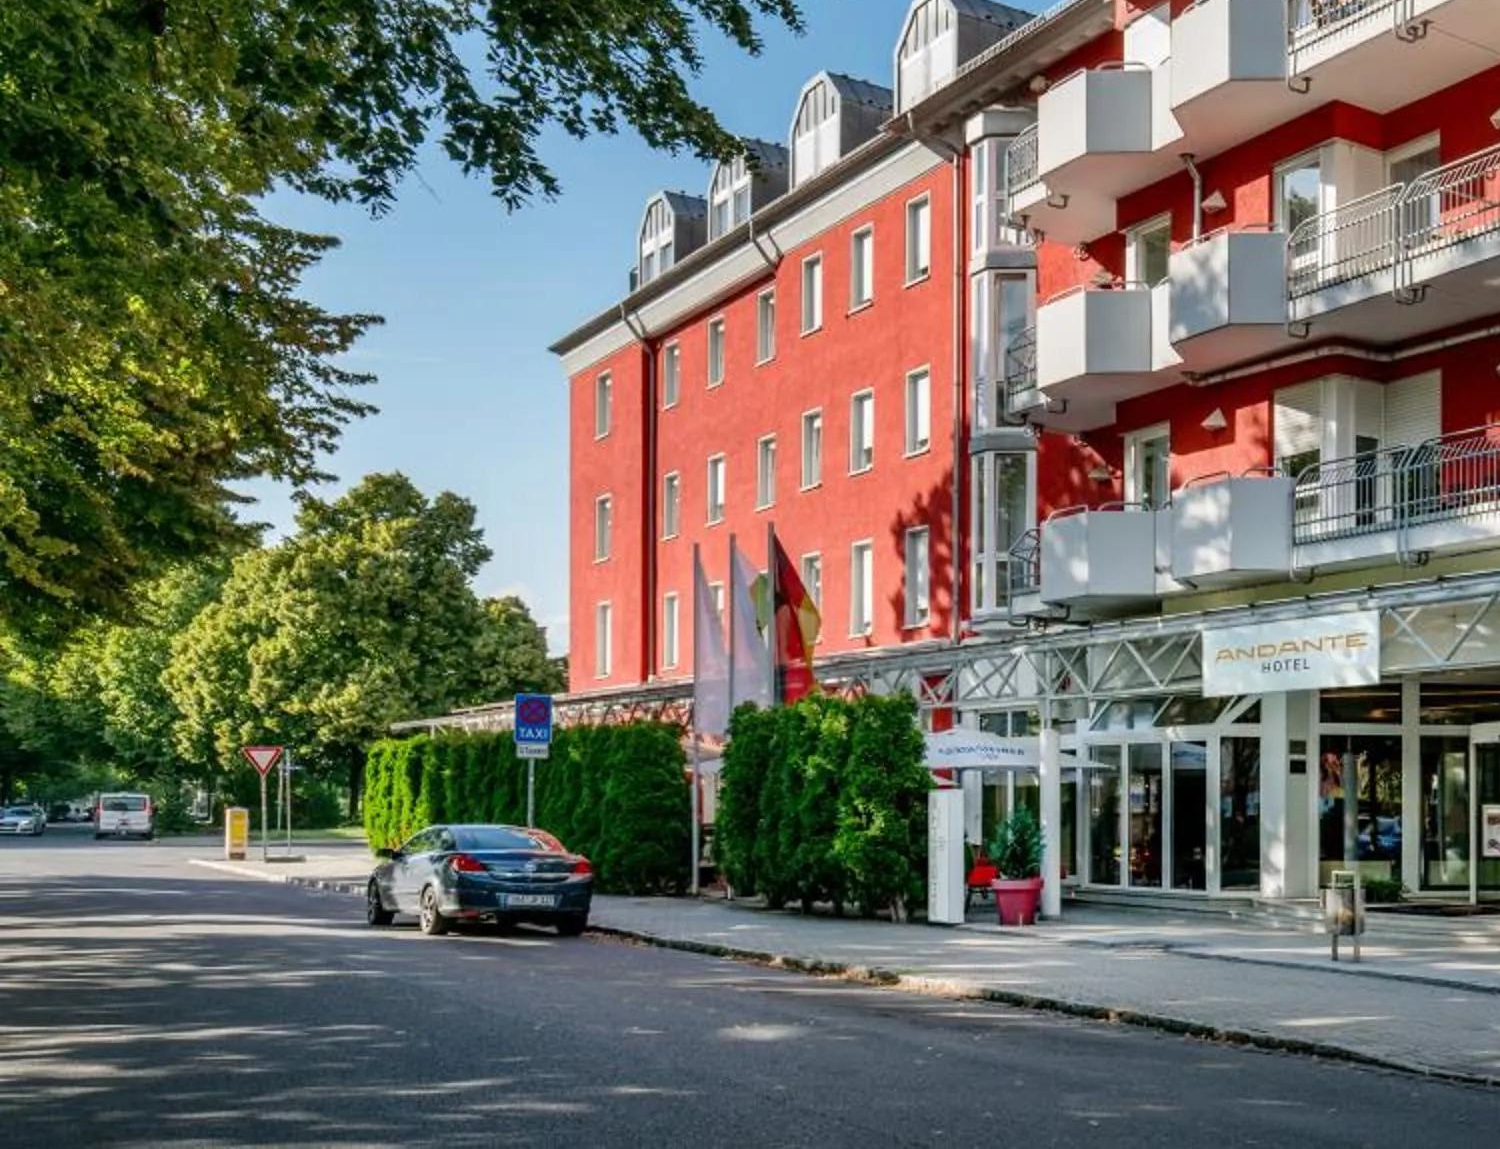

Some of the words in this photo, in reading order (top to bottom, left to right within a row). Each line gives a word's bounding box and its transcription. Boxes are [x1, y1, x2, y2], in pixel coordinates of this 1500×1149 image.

[1215, 632, 1369, 662] ANDANTE
[1261, 658, 1311, 674] HOTEL
[518, 727, 549, 740] TAXI
